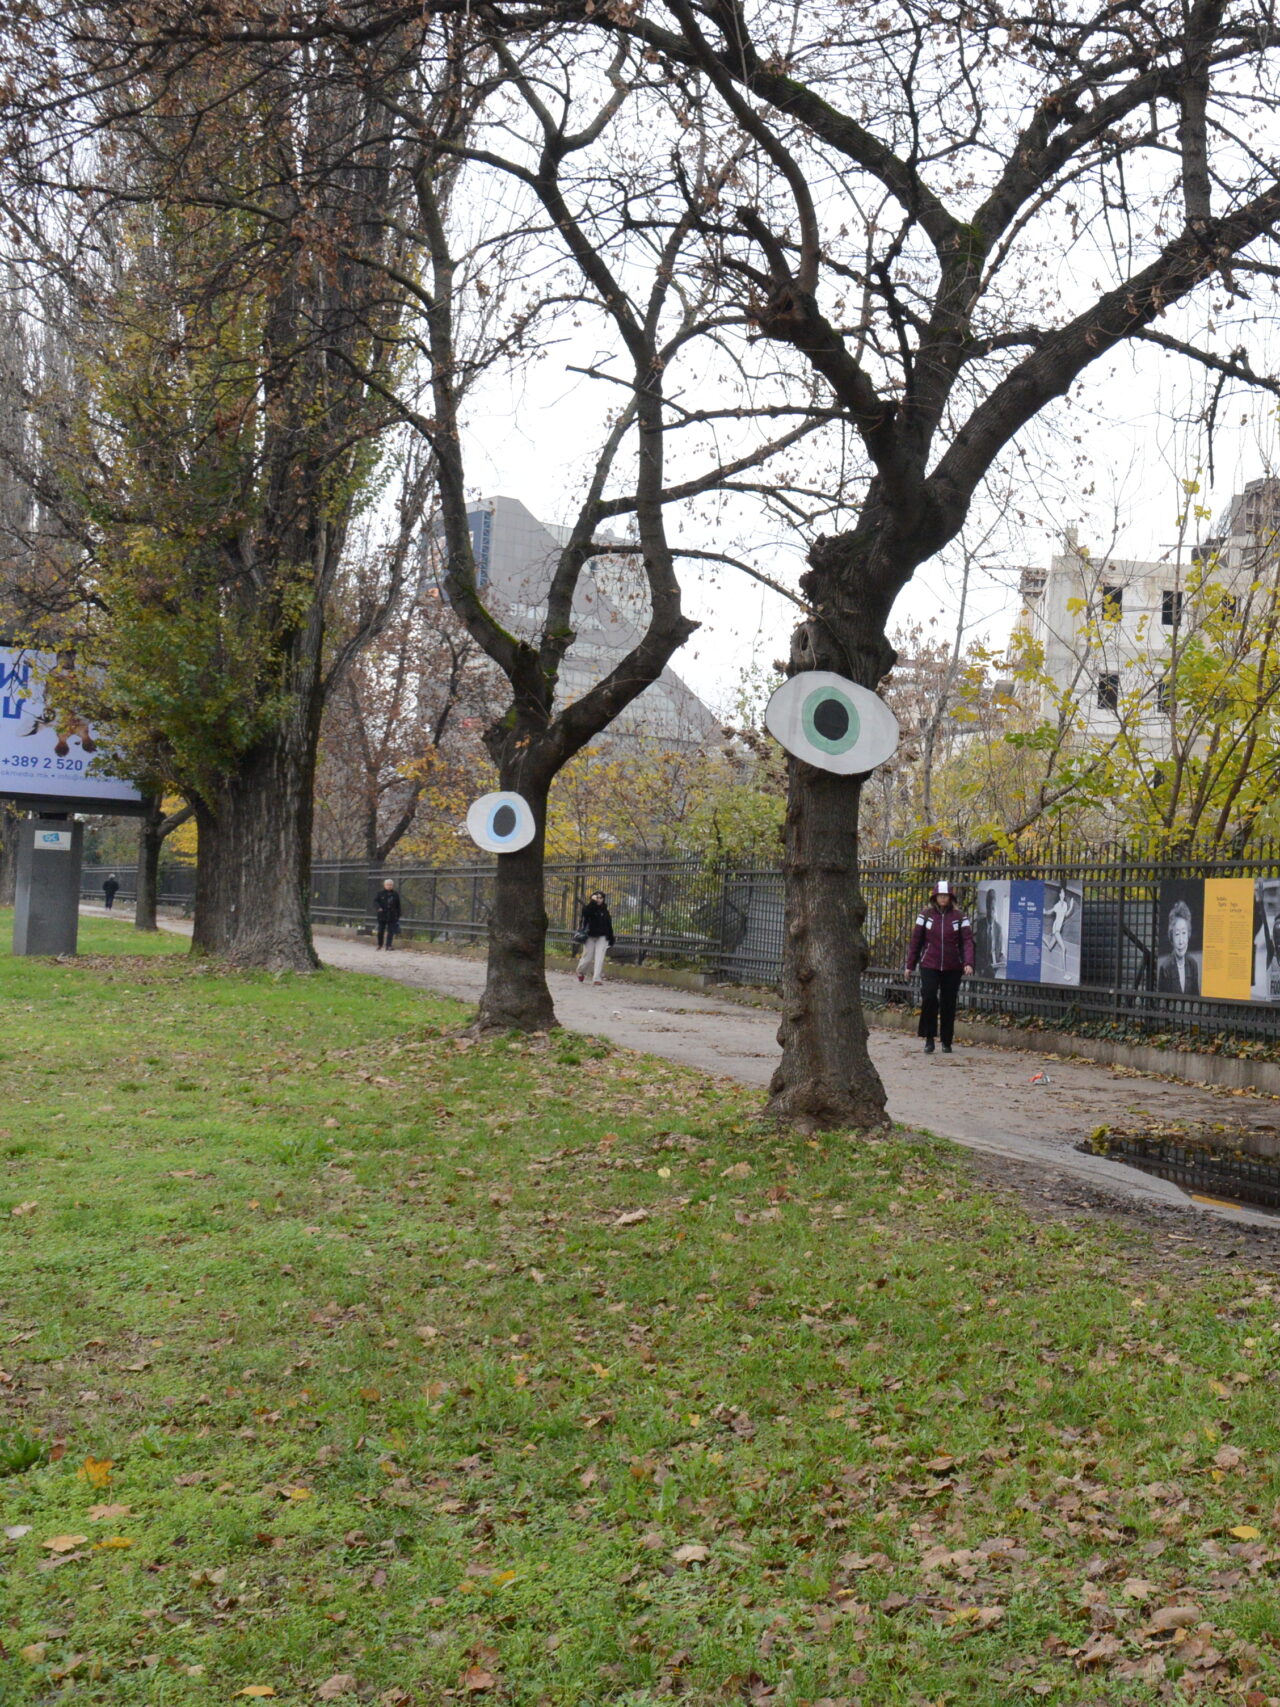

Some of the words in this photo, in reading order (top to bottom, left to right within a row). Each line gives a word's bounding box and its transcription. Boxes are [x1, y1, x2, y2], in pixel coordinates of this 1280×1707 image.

[2, 755, 38, 768] +389
[43, 757, 52, 769] 2
[56, 758, 83, 771] 520
